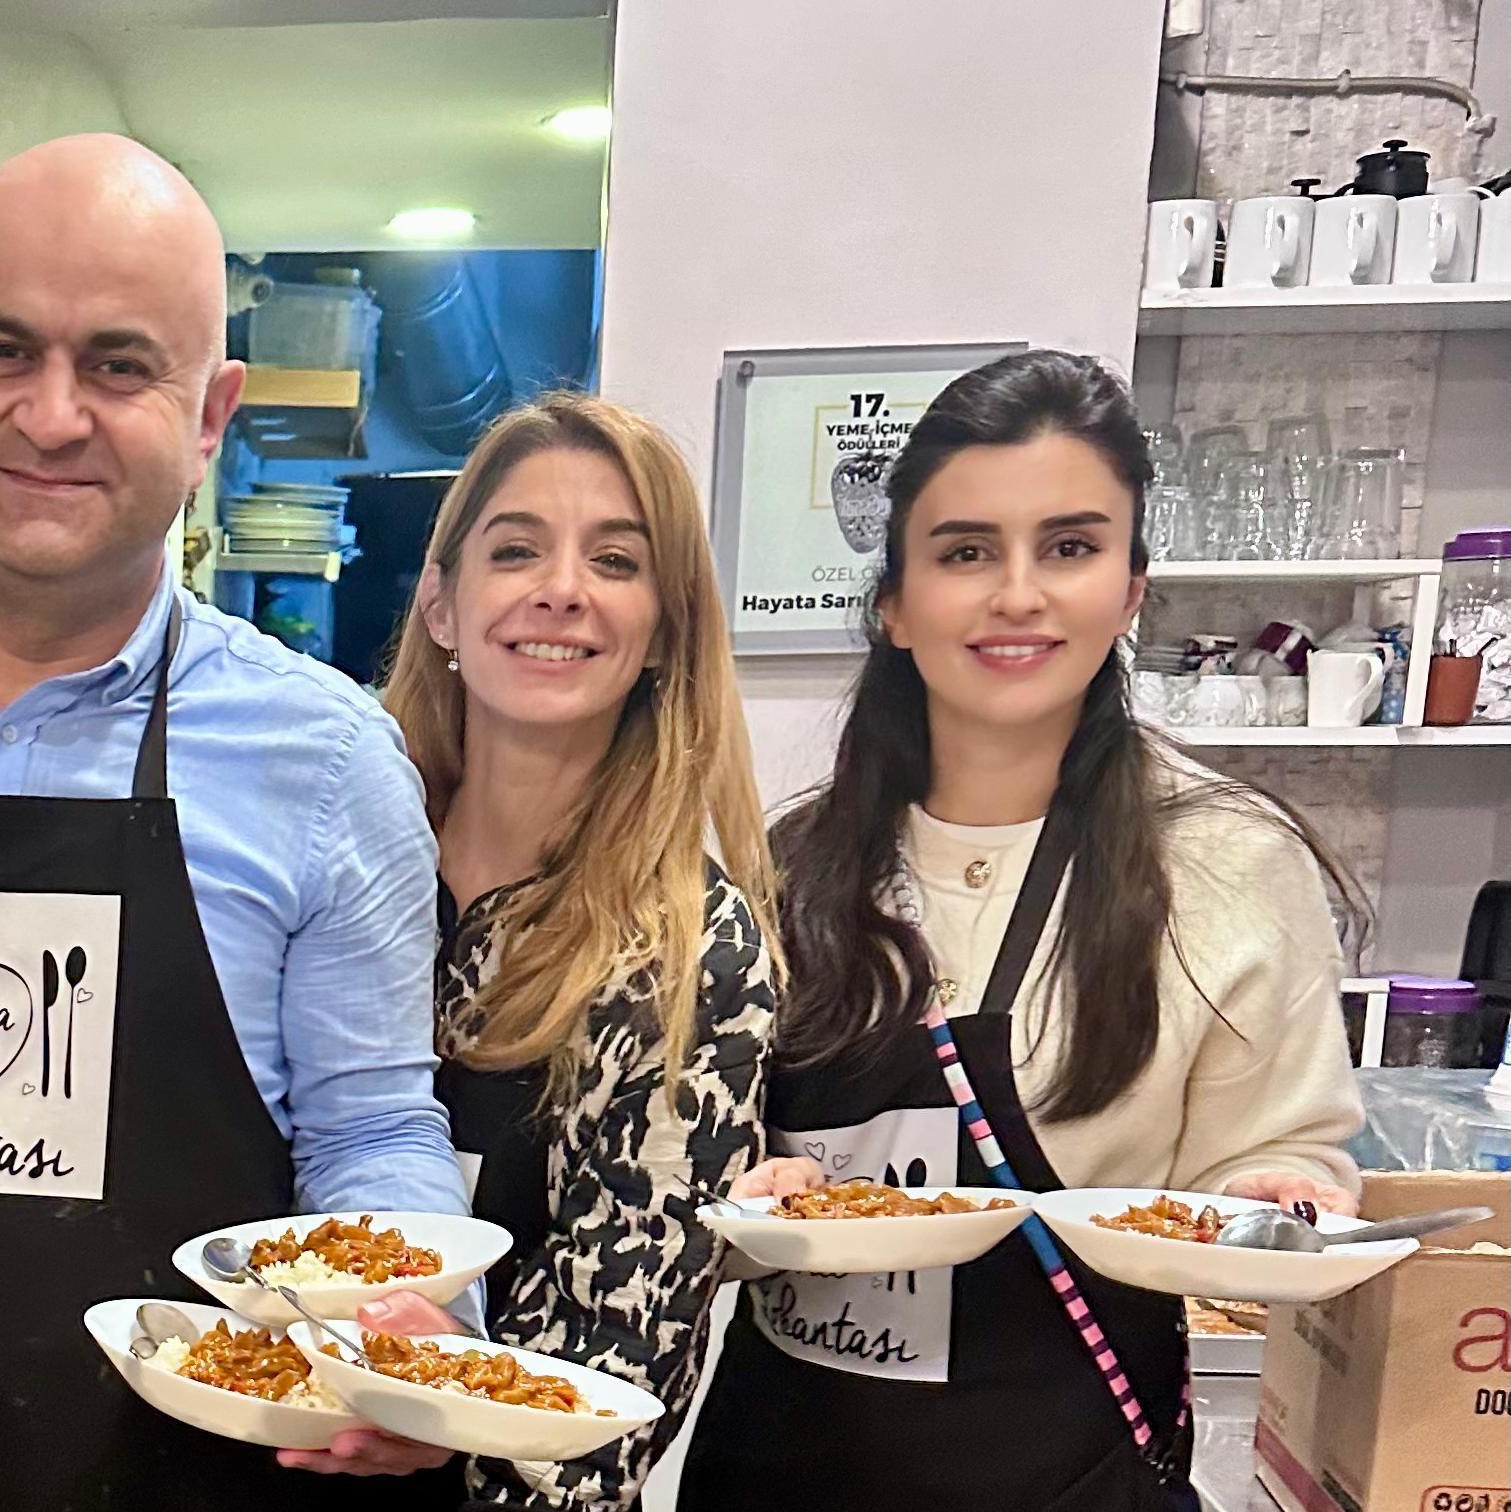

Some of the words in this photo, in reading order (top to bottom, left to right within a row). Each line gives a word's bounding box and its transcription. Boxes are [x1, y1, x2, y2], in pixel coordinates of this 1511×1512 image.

[850, 393, 890, 418] 17.
[812, 566, 856, 582] ÖZEL
[742, 595, 816, 614] Hayata
[821, 593, 863, 608] Sarı
[765, 1281, 919, 1362] kantası
[1475, 1388, 1511, 1416] DO
